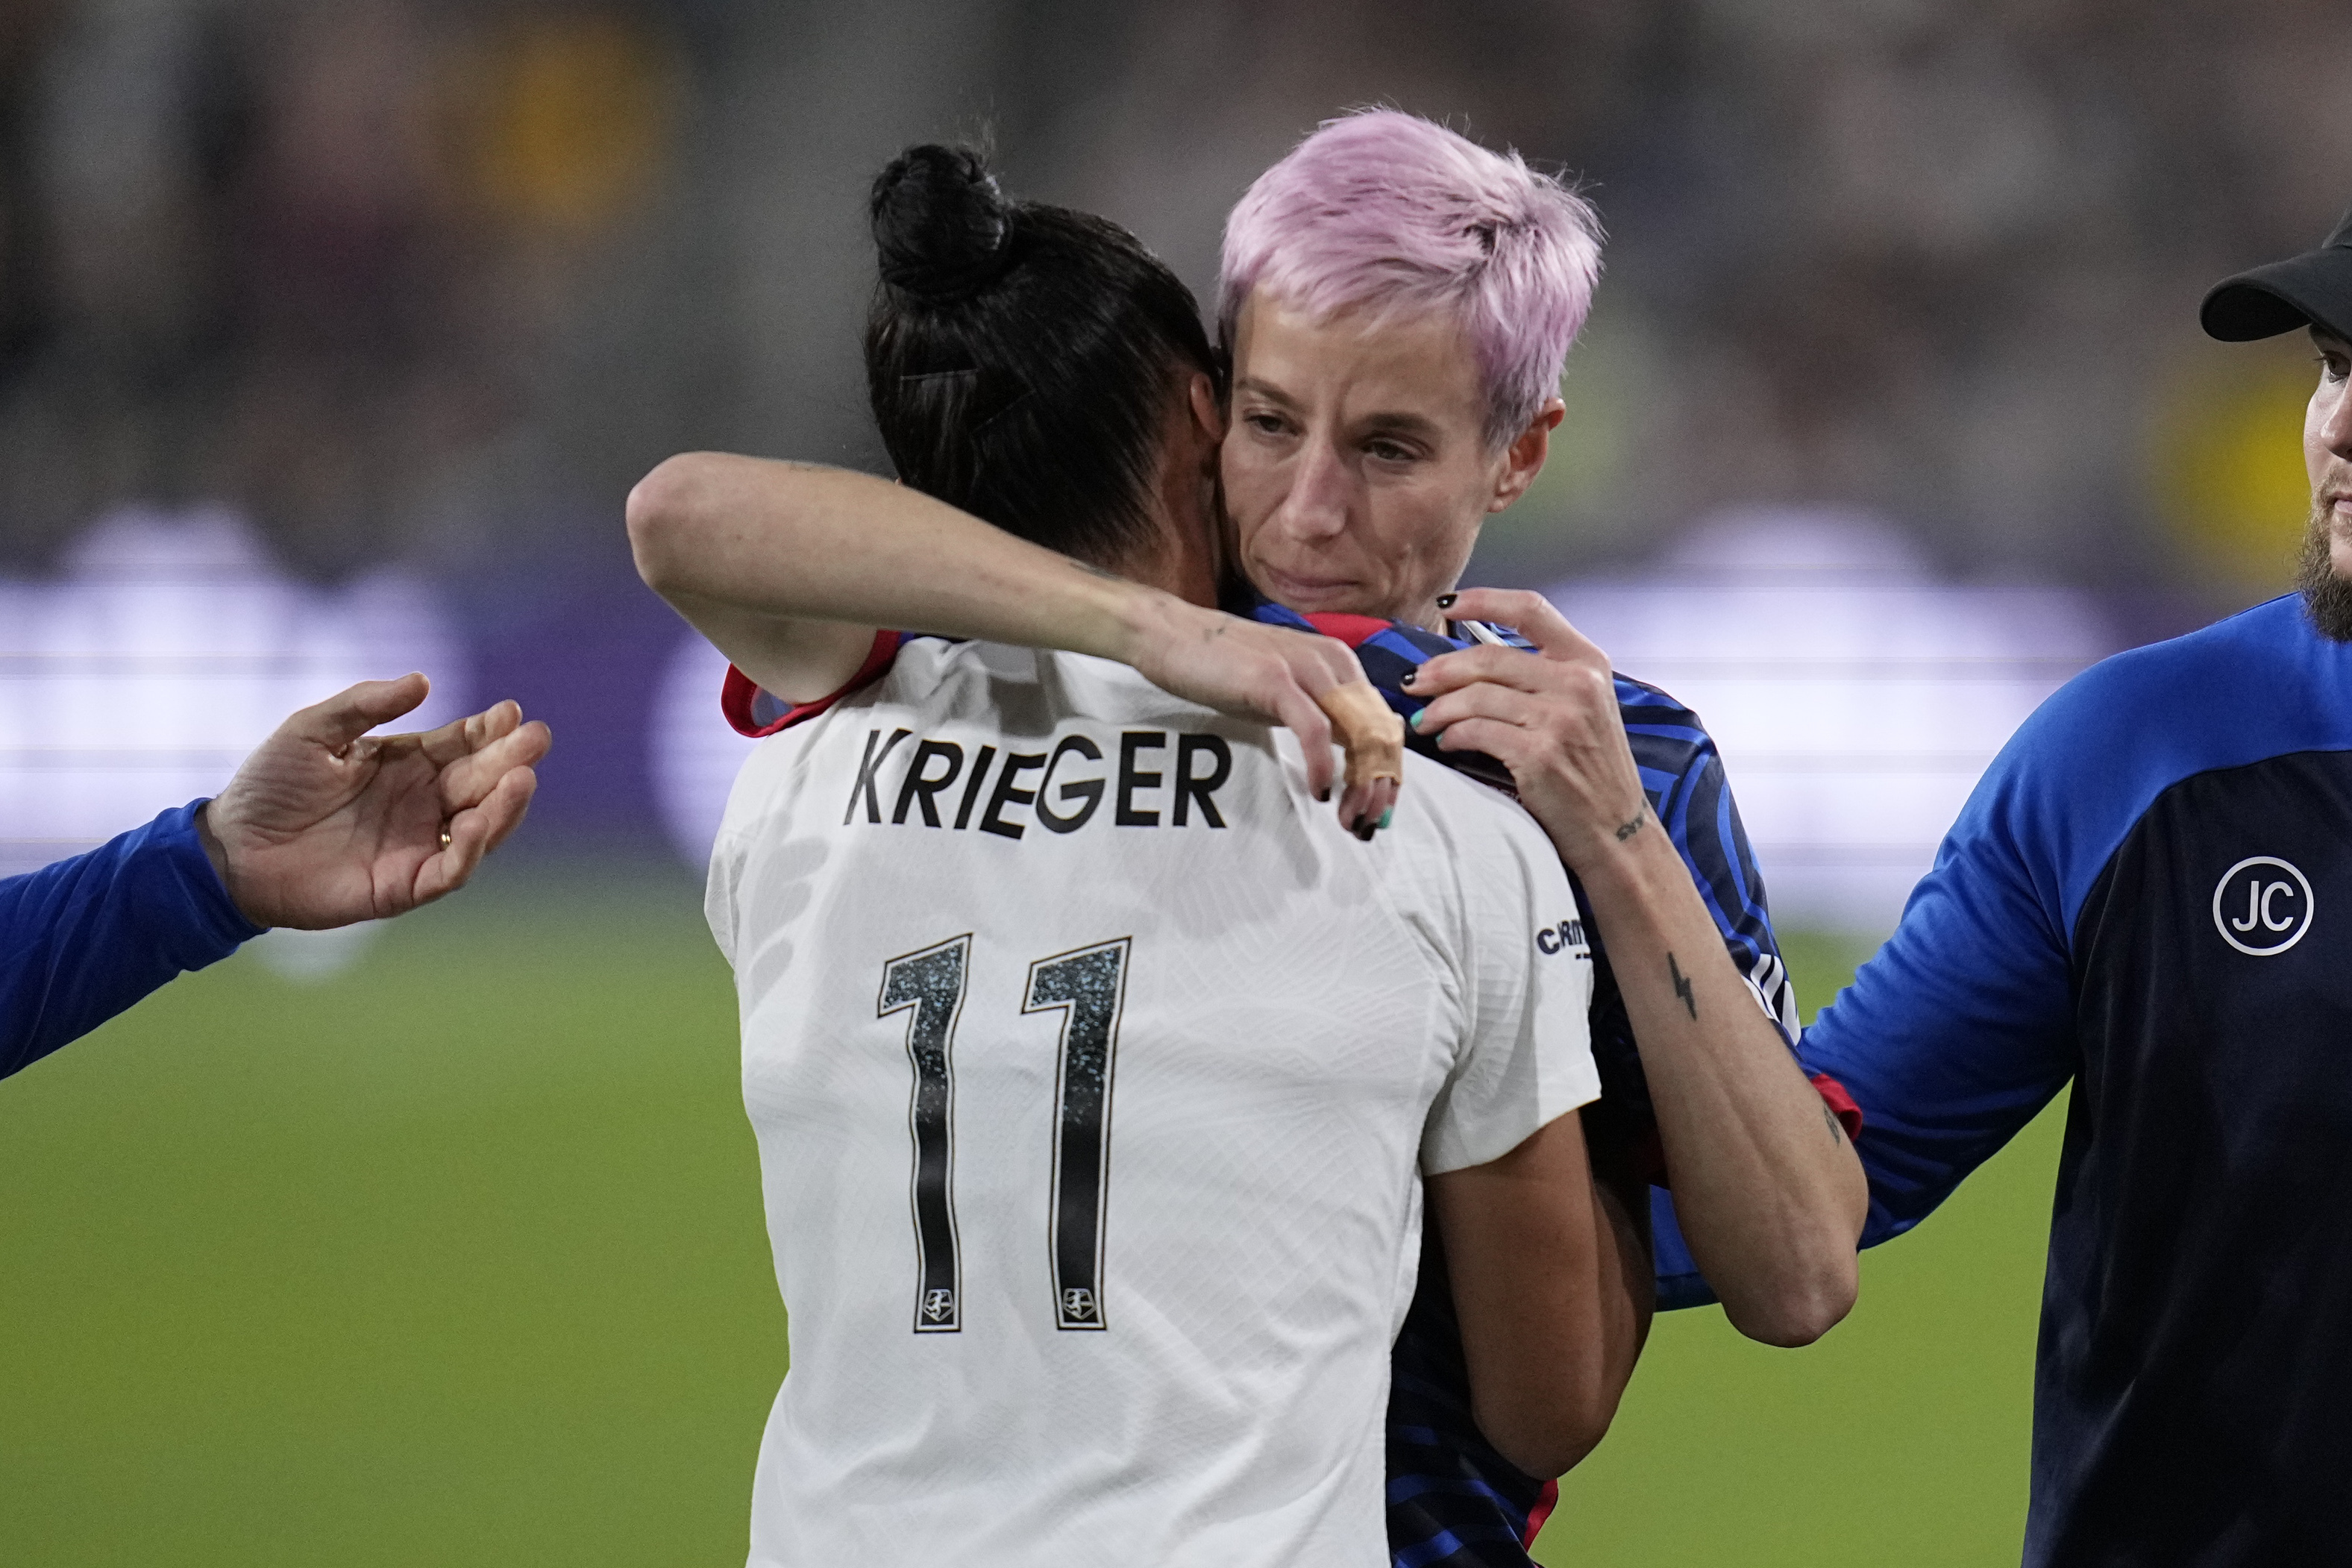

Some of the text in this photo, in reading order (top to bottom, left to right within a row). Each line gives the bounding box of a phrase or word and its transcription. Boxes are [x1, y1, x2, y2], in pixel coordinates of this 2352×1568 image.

[844, 728, 1232, 840] KRIEGER
[2232, 880, 2294, 932] JC
[877, 932, 1132, 1333] 11
